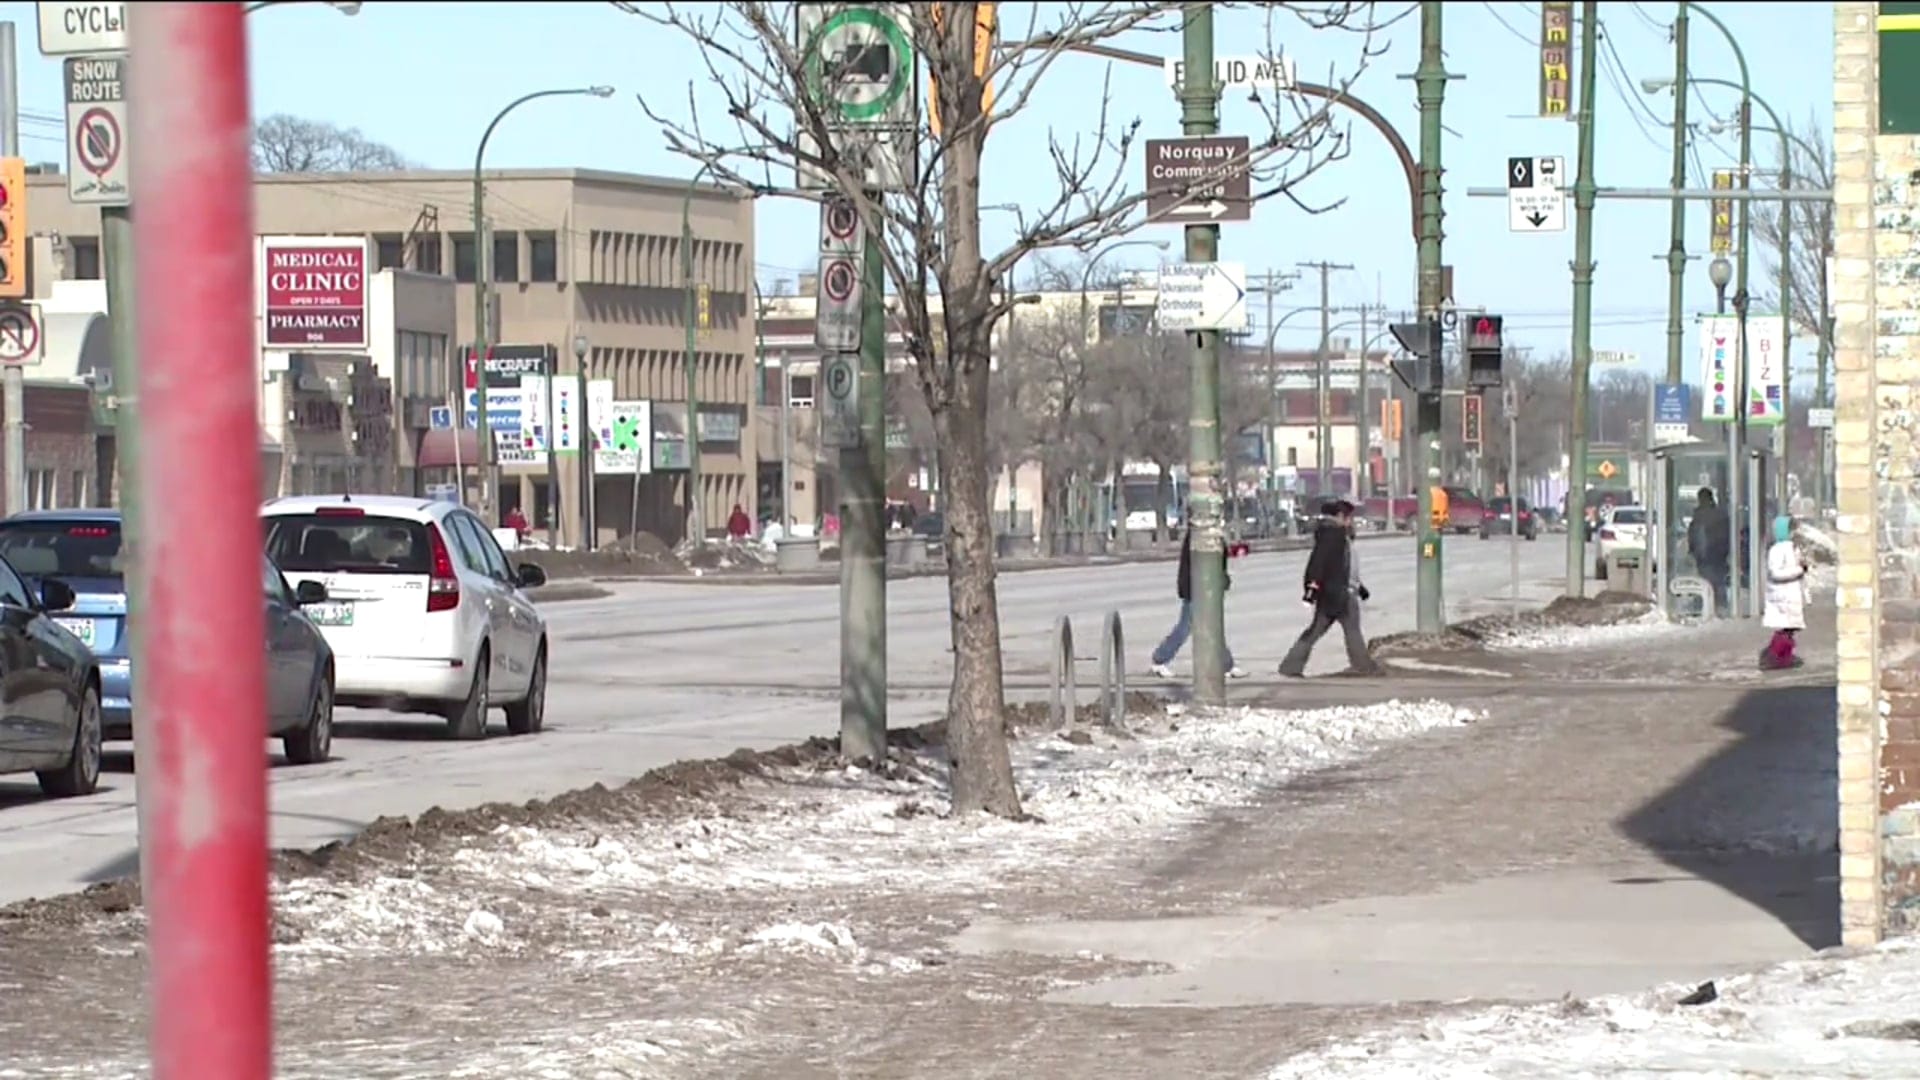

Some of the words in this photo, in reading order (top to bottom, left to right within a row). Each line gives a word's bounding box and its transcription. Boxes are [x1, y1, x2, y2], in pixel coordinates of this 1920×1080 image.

[73, 61, 118, 80] SNOW
[1174, 60, 1247, 84] ELID
[1254, 62, 1283, 81] AVE
[71, 80, 121, 101] ROUTE
[1160, 145, 1236, 160] Norquay
[272, 253, 358, 267] MEDICAL
[271, 273, 360, 291] CLINIC
[1161, 283, 1204, 293] Ukrainian
[290, 297, 313, 305] OPEN
[1161, 299, 1203, 310] Orthodox
[271, 315, 360, 328] PHARMACY
[1162, 315, 1194, 326] Church
[467, 359, 542, 373] TRECRAFT
[1759, 338, 1771, 380] BIZ
[1713, 337, 1727, 415] WELCOME
